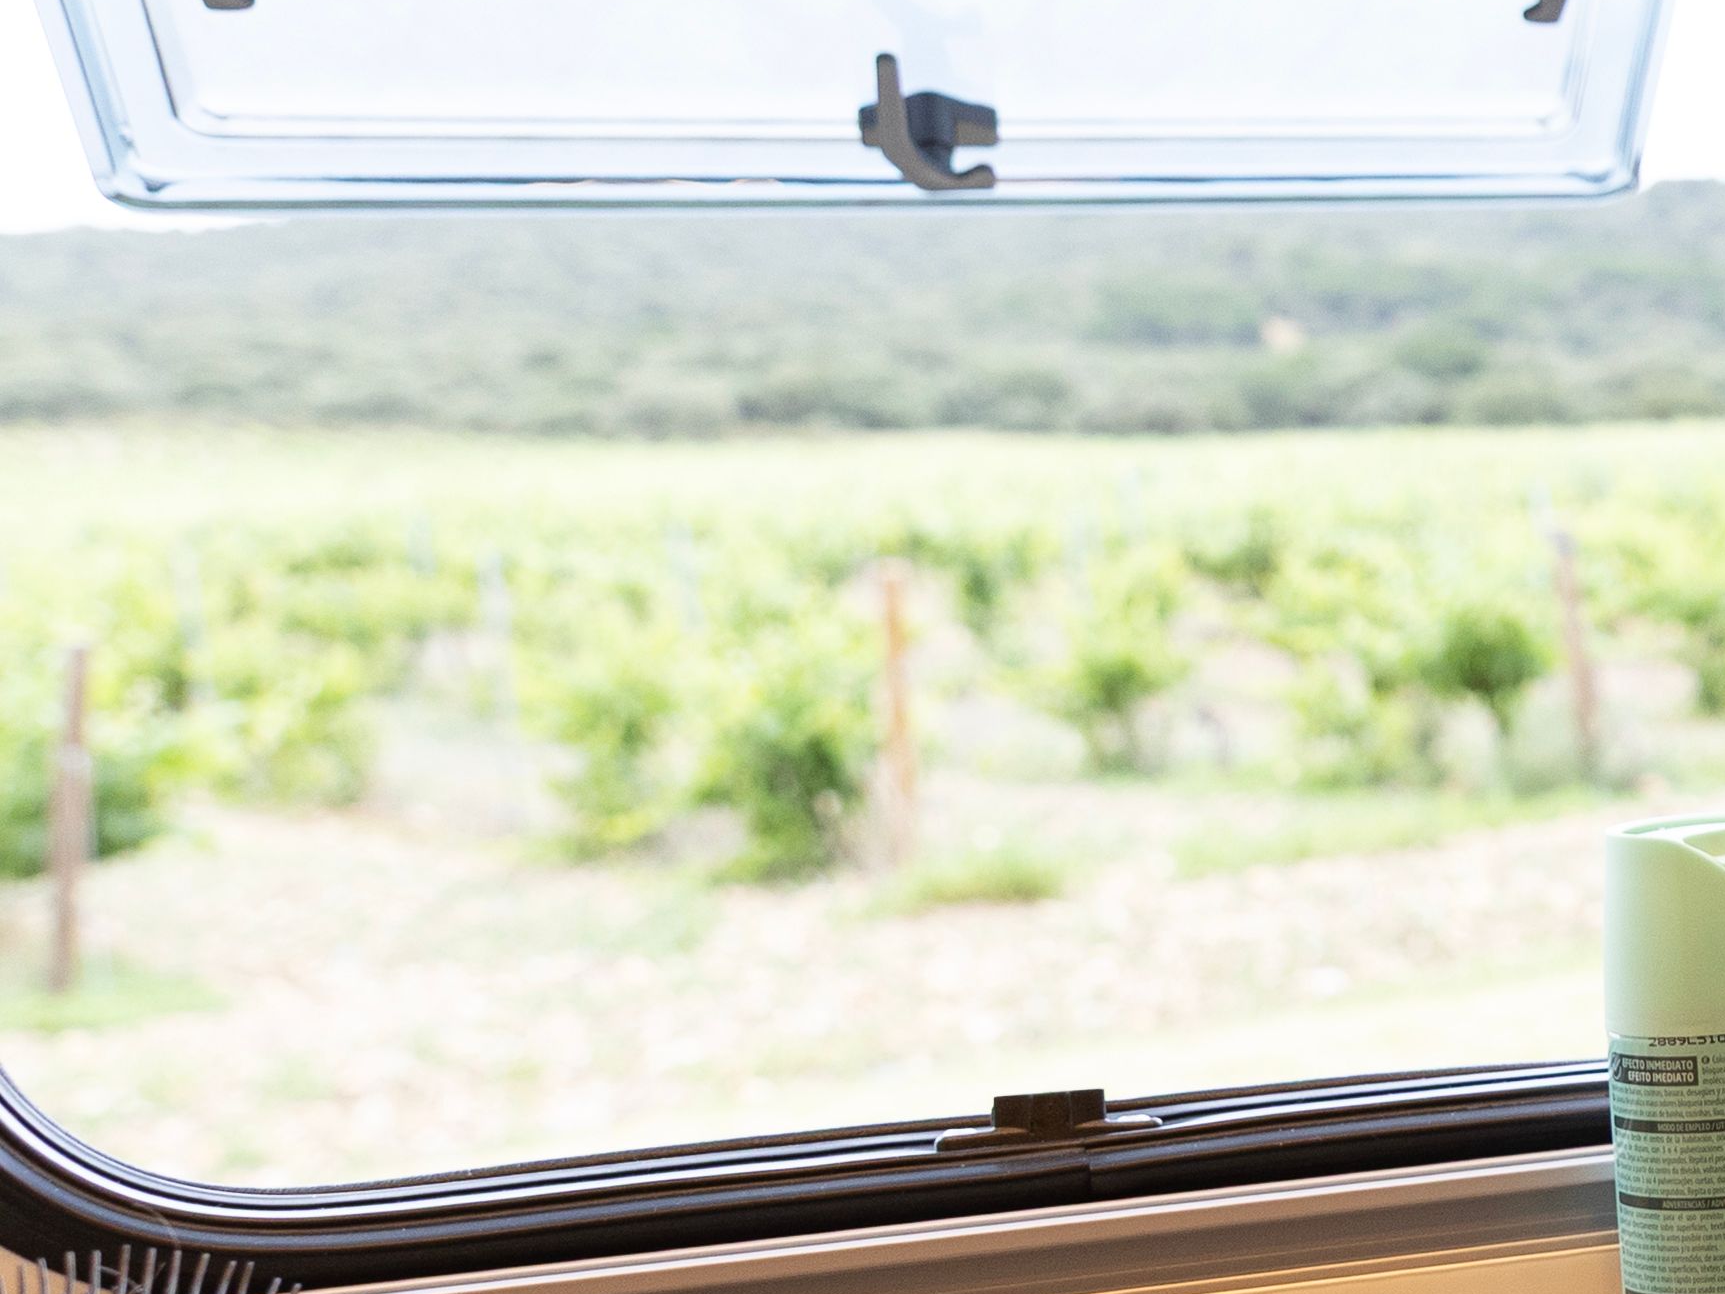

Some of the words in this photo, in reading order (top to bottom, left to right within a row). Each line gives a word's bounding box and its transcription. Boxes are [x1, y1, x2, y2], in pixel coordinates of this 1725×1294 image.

[1622, 1056, 1645, 1070] EFECTO
[1646, 1060, 1693, 1071] INMEDIATO
[1628, 1069, 1651, 1082] EFEITO
[1652, 1071, 1694, 1083] IMEDIATO
[1657, 1123, 1674, 1132] MODO
[1683, 1121, 1710, 1132] EMPLEO
[1662, 1200, 1706, 1209] ADVERTENCIAS
